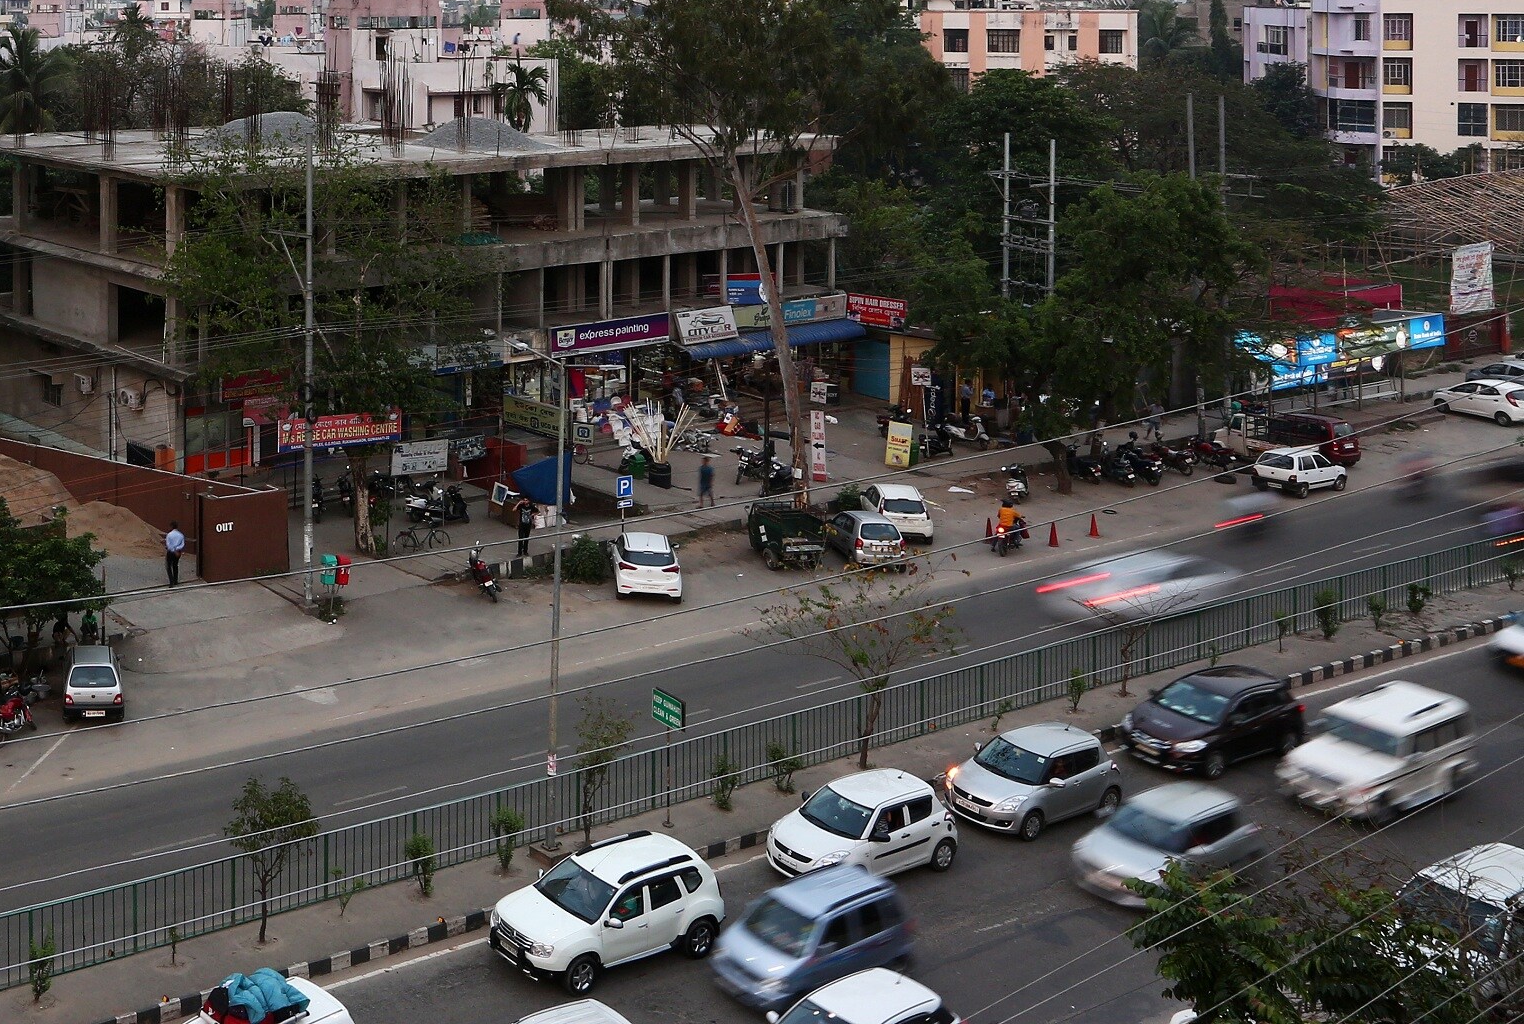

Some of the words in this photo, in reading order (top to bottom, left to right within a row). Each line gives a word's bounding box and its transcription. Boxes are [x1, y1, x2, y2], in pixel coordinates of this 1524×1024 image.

[865, 298, 878, 306] HAIR
[879, 300, 904, 310] DRESSER
[784, 308, 812, 319] Finolex
[579, 328, 614, 340] express
[615, 323, 649, 336] painting
[322, 428, 336, 439] CAR
[337, 424, 370, 438] WASHING
[371, 422, 397, 435] CENTRE
[540, 422, 551, 430] UCO
[620, 479, 630, 494] P
[215, 522, 234, 532] OUT
[654, 694, 662, 704] KEEP
[654, 706, 664, 717] CLEAN
